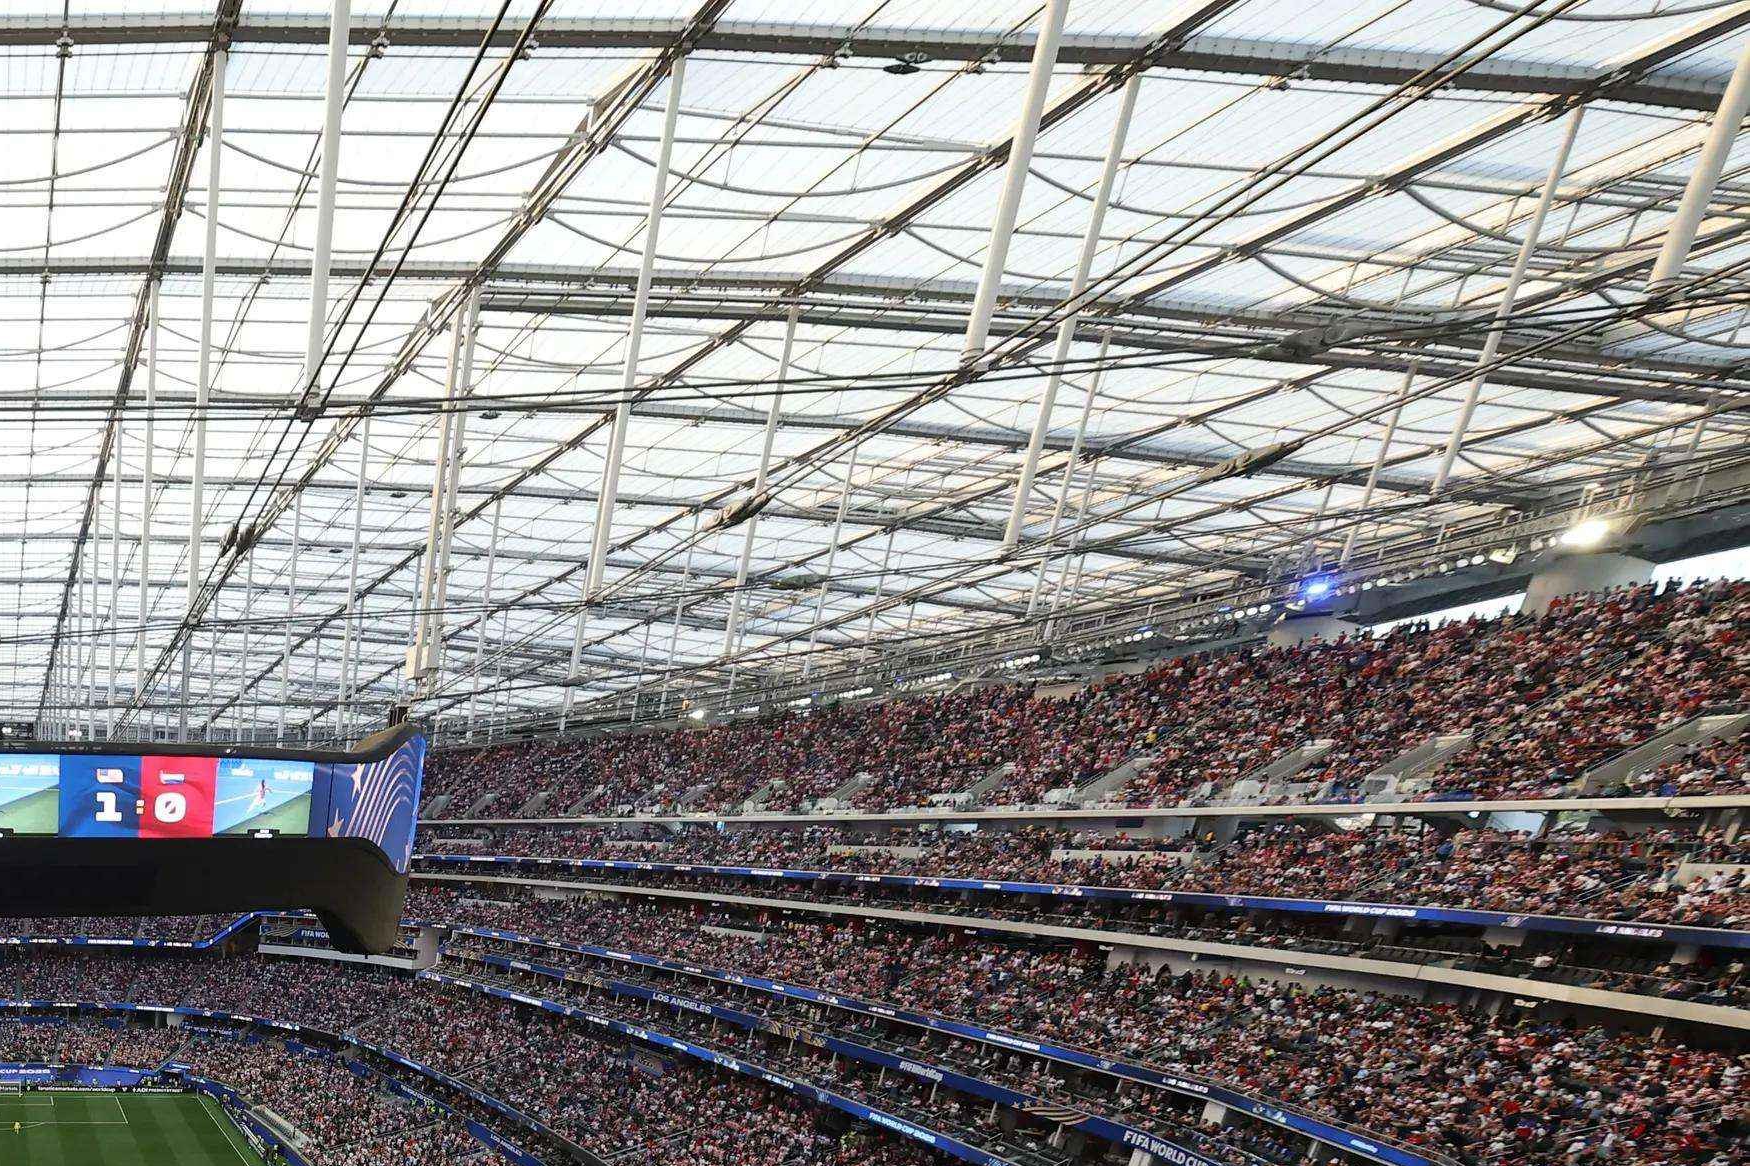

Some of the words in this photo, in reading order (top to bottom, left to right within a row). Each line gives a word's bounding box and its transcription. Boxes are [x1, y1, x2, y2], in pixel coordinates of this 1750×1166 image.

[95, 791, 122, 821] 1
[154, 791, 187, 822] 0
[652, 992, 669, 1003] LOS
[670, 997, 712, 1014] ANGELES
[1123, 1130, 1150, 1151] FIFA
